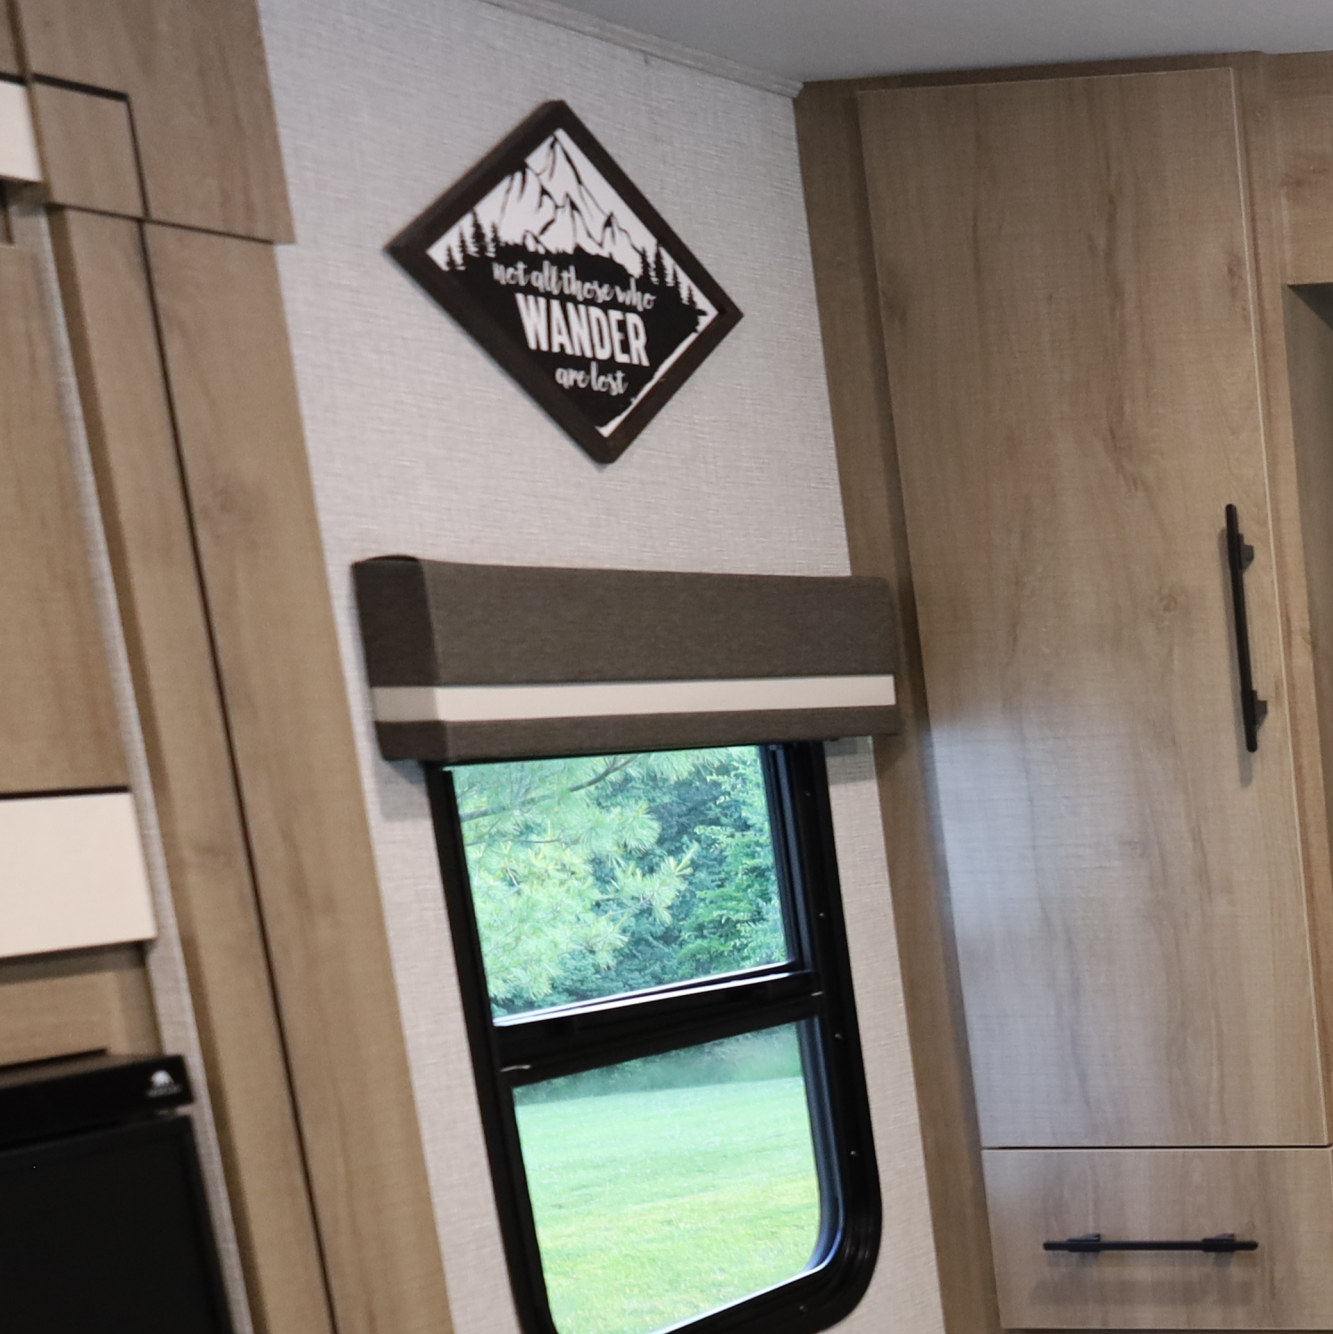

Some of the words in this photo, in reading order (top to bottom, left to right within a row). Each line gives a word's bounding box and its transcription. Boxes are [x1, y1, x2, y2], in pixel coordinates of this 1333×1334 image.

[492, 261, 530, 286] not
[530, 260, 562, 295] all
[561, 265, 616, 302] those
[615, 277, 657, 312] who
[515, 292, 650, 367] WANDER
[555, 367, 591, 389] are
[590, 360, 629, 396] lost
